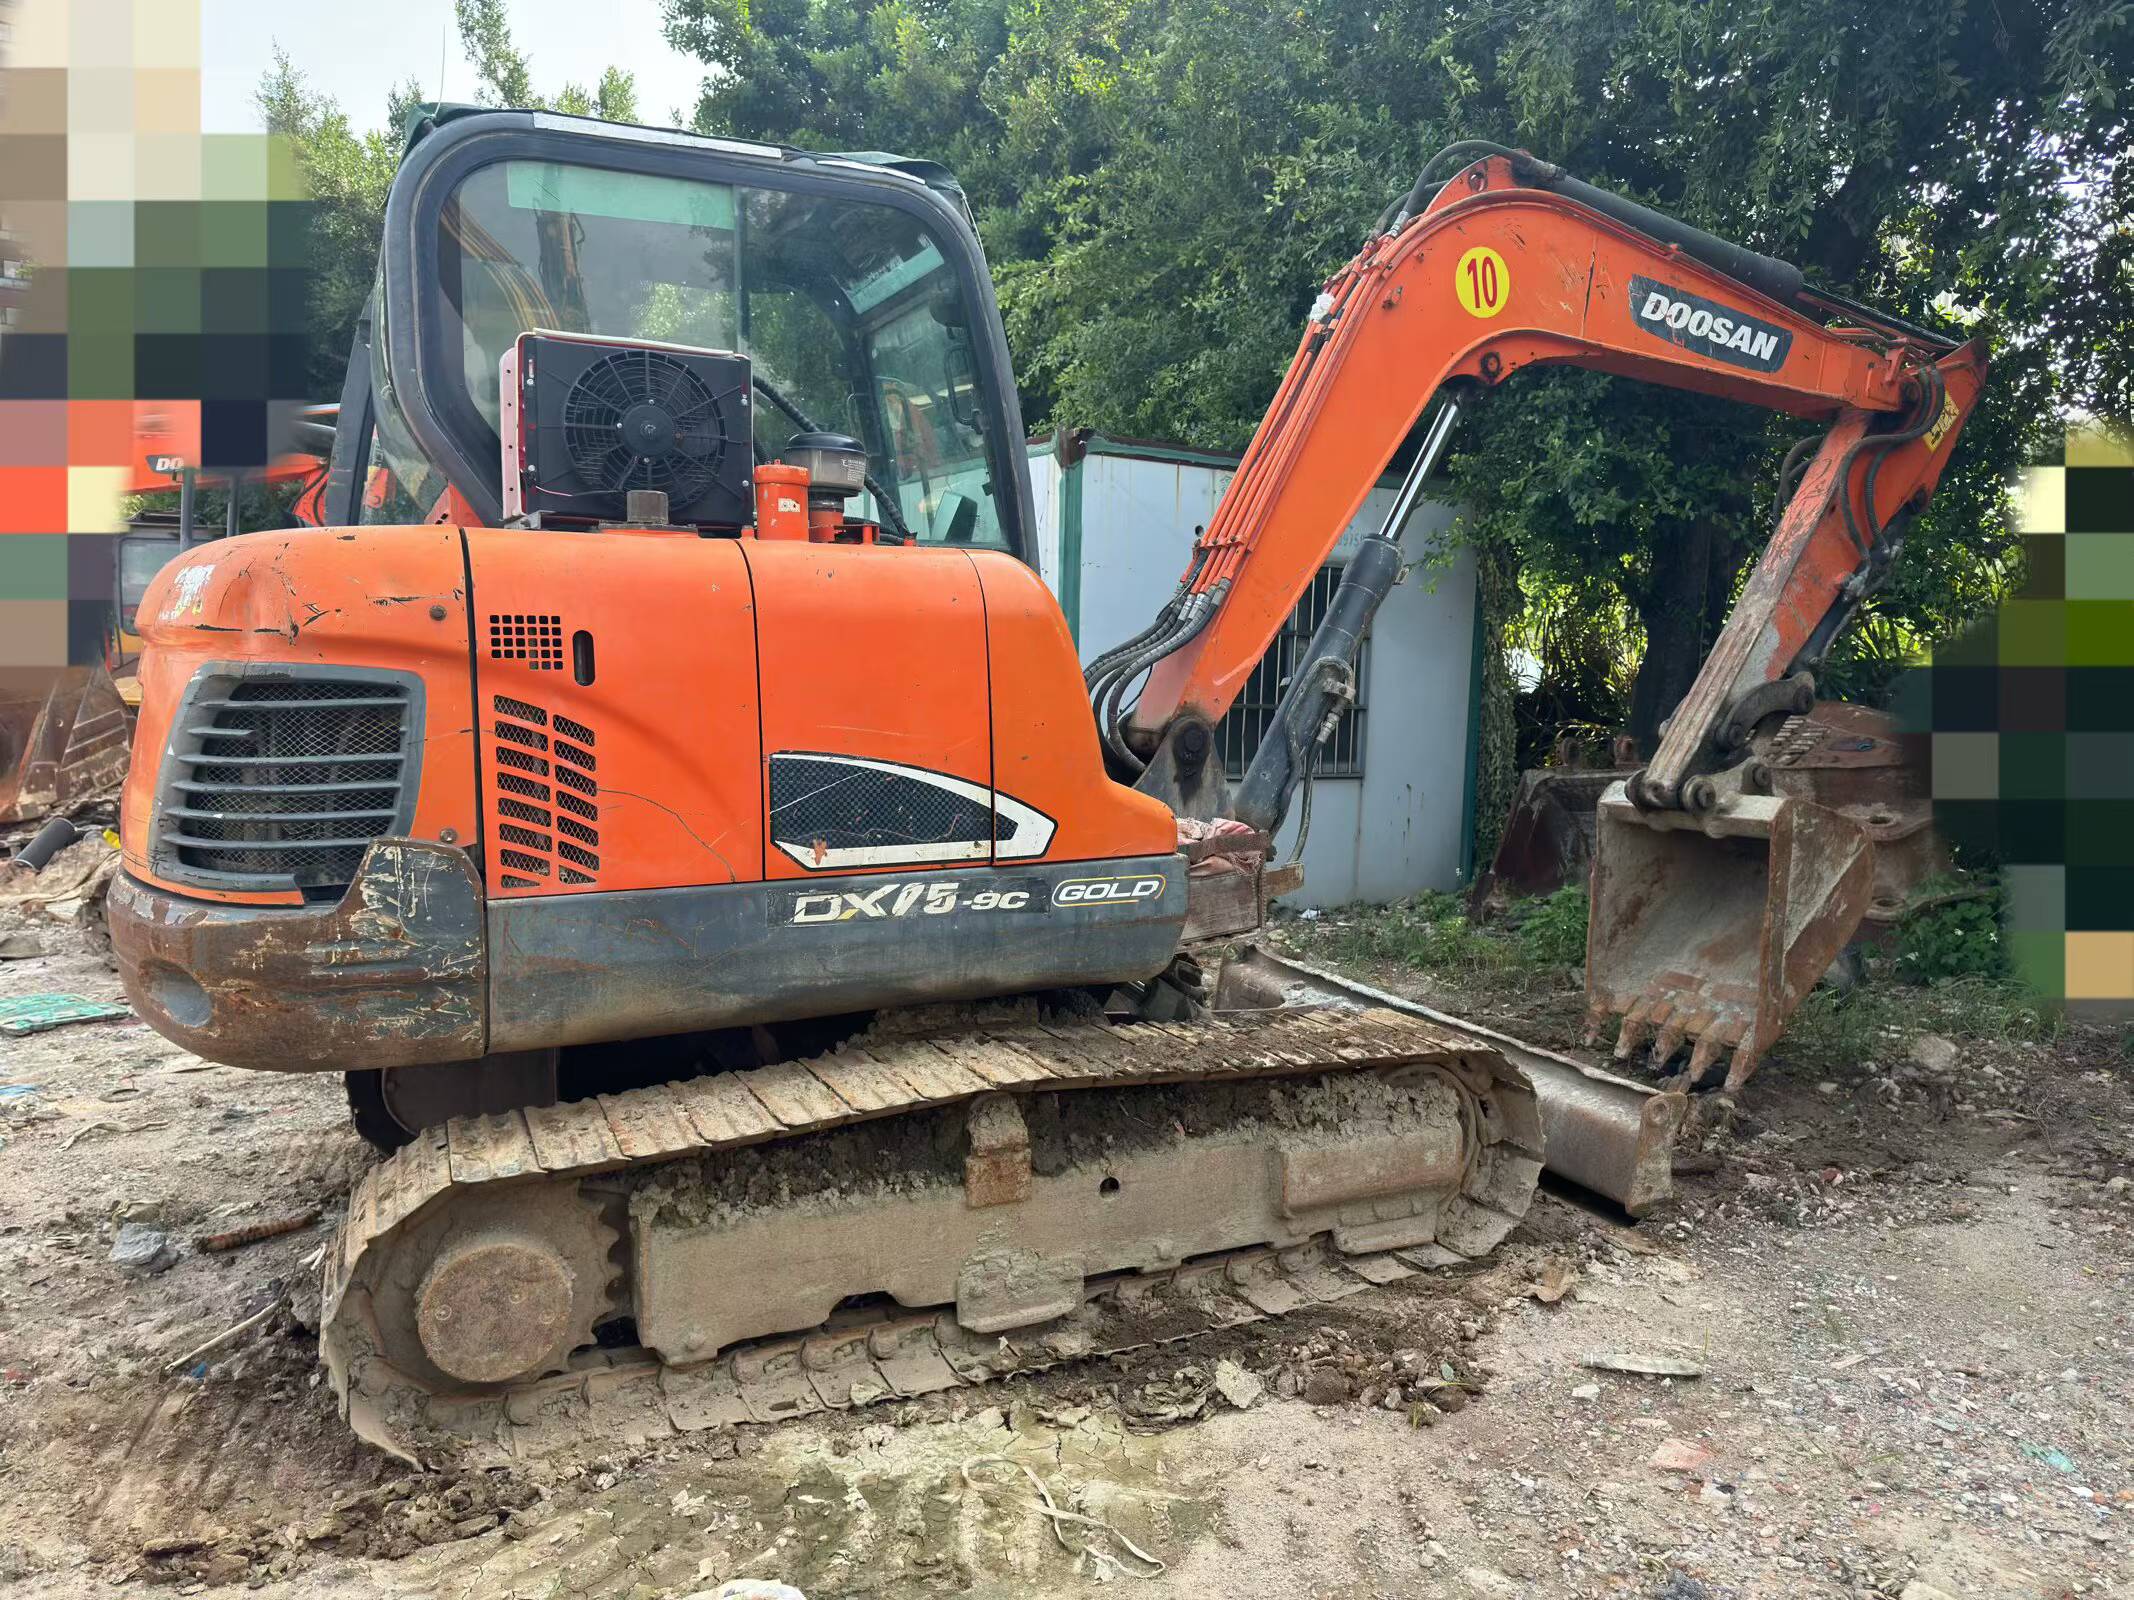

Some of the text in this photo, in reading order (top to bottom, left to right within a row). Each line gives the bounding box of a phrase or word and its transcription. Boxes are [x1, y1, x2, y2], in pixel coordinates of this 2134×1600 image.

[1467, 256, 1498, 309] 10
[1641, 292, 1779, 361] DOOSAN
[1058, 880, 1160, 901] GOLD
